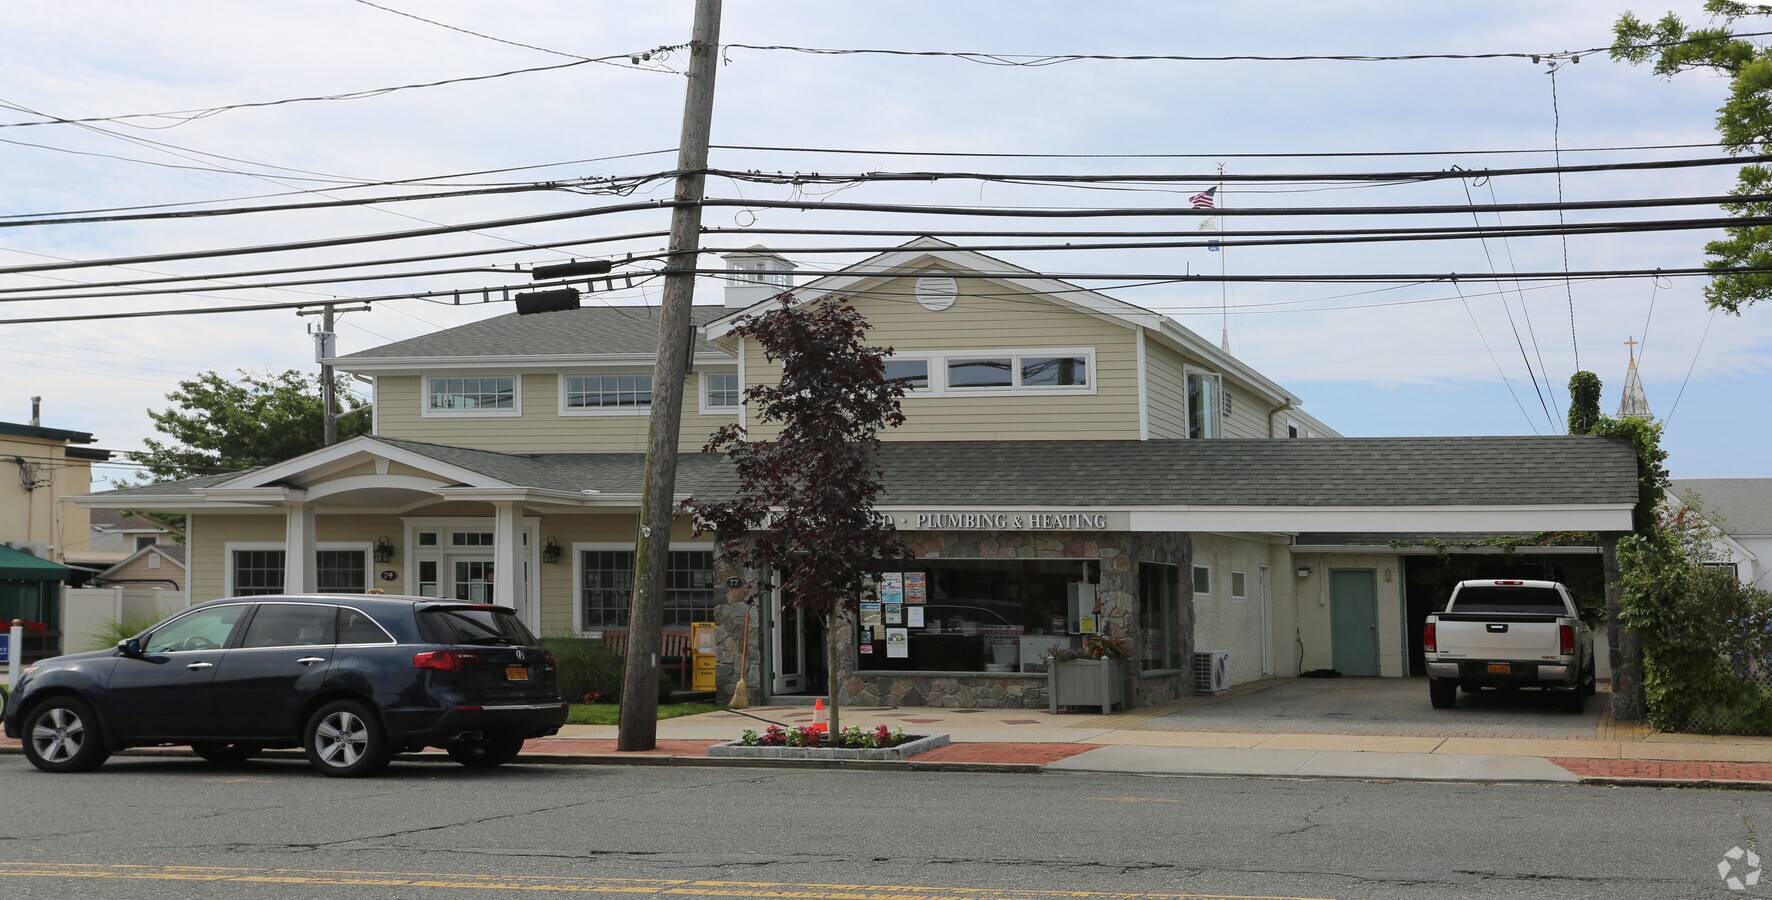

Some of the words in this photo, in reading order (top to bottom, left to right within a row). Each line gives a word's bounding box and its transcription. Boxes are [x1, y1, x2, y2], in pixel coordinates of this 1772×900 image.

[915, 513, 1007, 529] PLUMBING
[1012, 514, 1024, 529] &
[1028, 513, 1107, 529] HEATING
